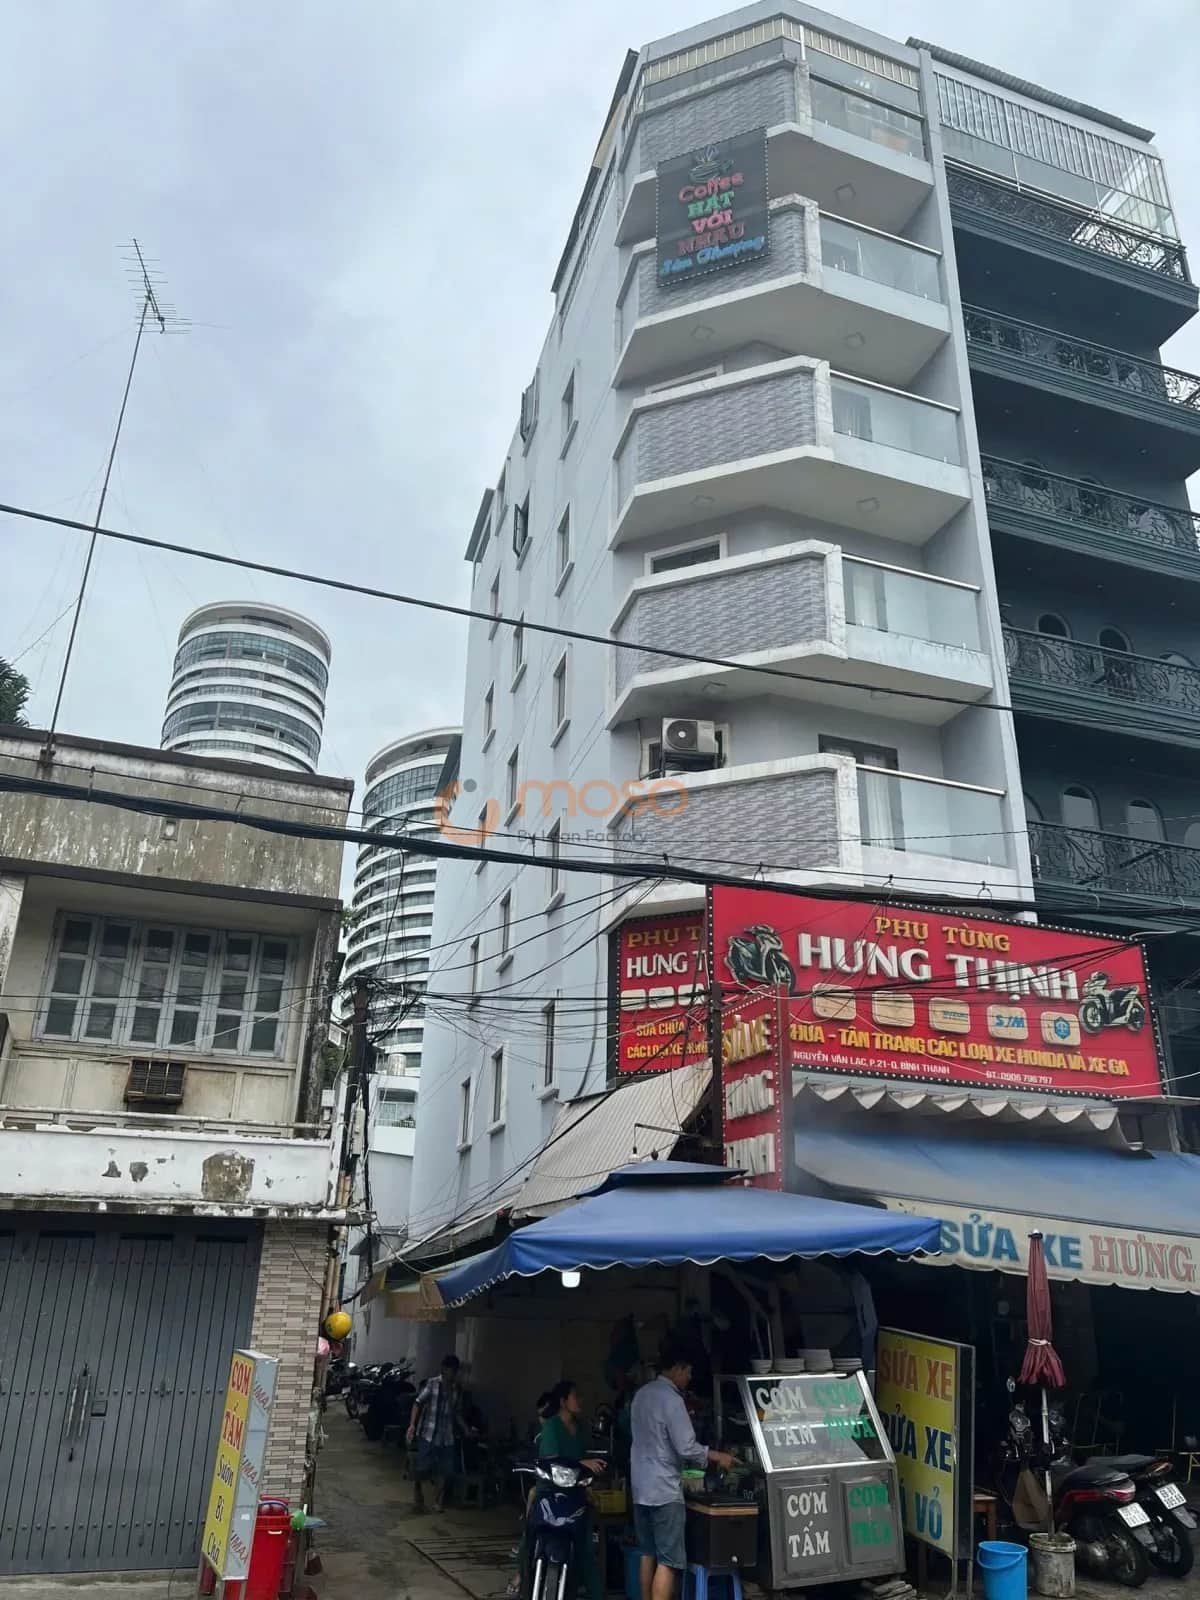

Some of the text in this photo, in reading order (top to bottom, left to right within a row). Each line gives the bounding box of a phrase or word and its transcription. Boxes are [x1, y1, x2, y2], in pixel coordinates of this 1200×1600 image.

[679, 172, 744, 203] Coffee
[627, 928, 680, 948] PHỤ
[874, 916, 1011, 952] PHỤ TÙNG
[626, 952, 688, 978] HƯNG
[798, 932, 1080, 1001] HƯNG THỊNH
[872, 1032, 926, 1054] TRANG
[927, 1037, 958, 1059] CÁC
[959, 1042, 993, 1064] LOẠI
[995, 1046, 1017, 1064] XE
[1017, 1048, 1067, 1069] HONDA
[1088, 1056, 1108, 1074] XE
[1108, 1059, 1130, 1076] GA
[939, 1214, 1020, 1262] SỬA
[1089, 1234, 1196, 1283] HƯNG
[925, 1358, 953, 1402] XE
[924, 1426, 952, 1473] XE
[787, 1490, 828, 1518] CƠM
[914, 1485, 943, 1541] VỎ
[788, 1520, 831, 1558] TẤM
